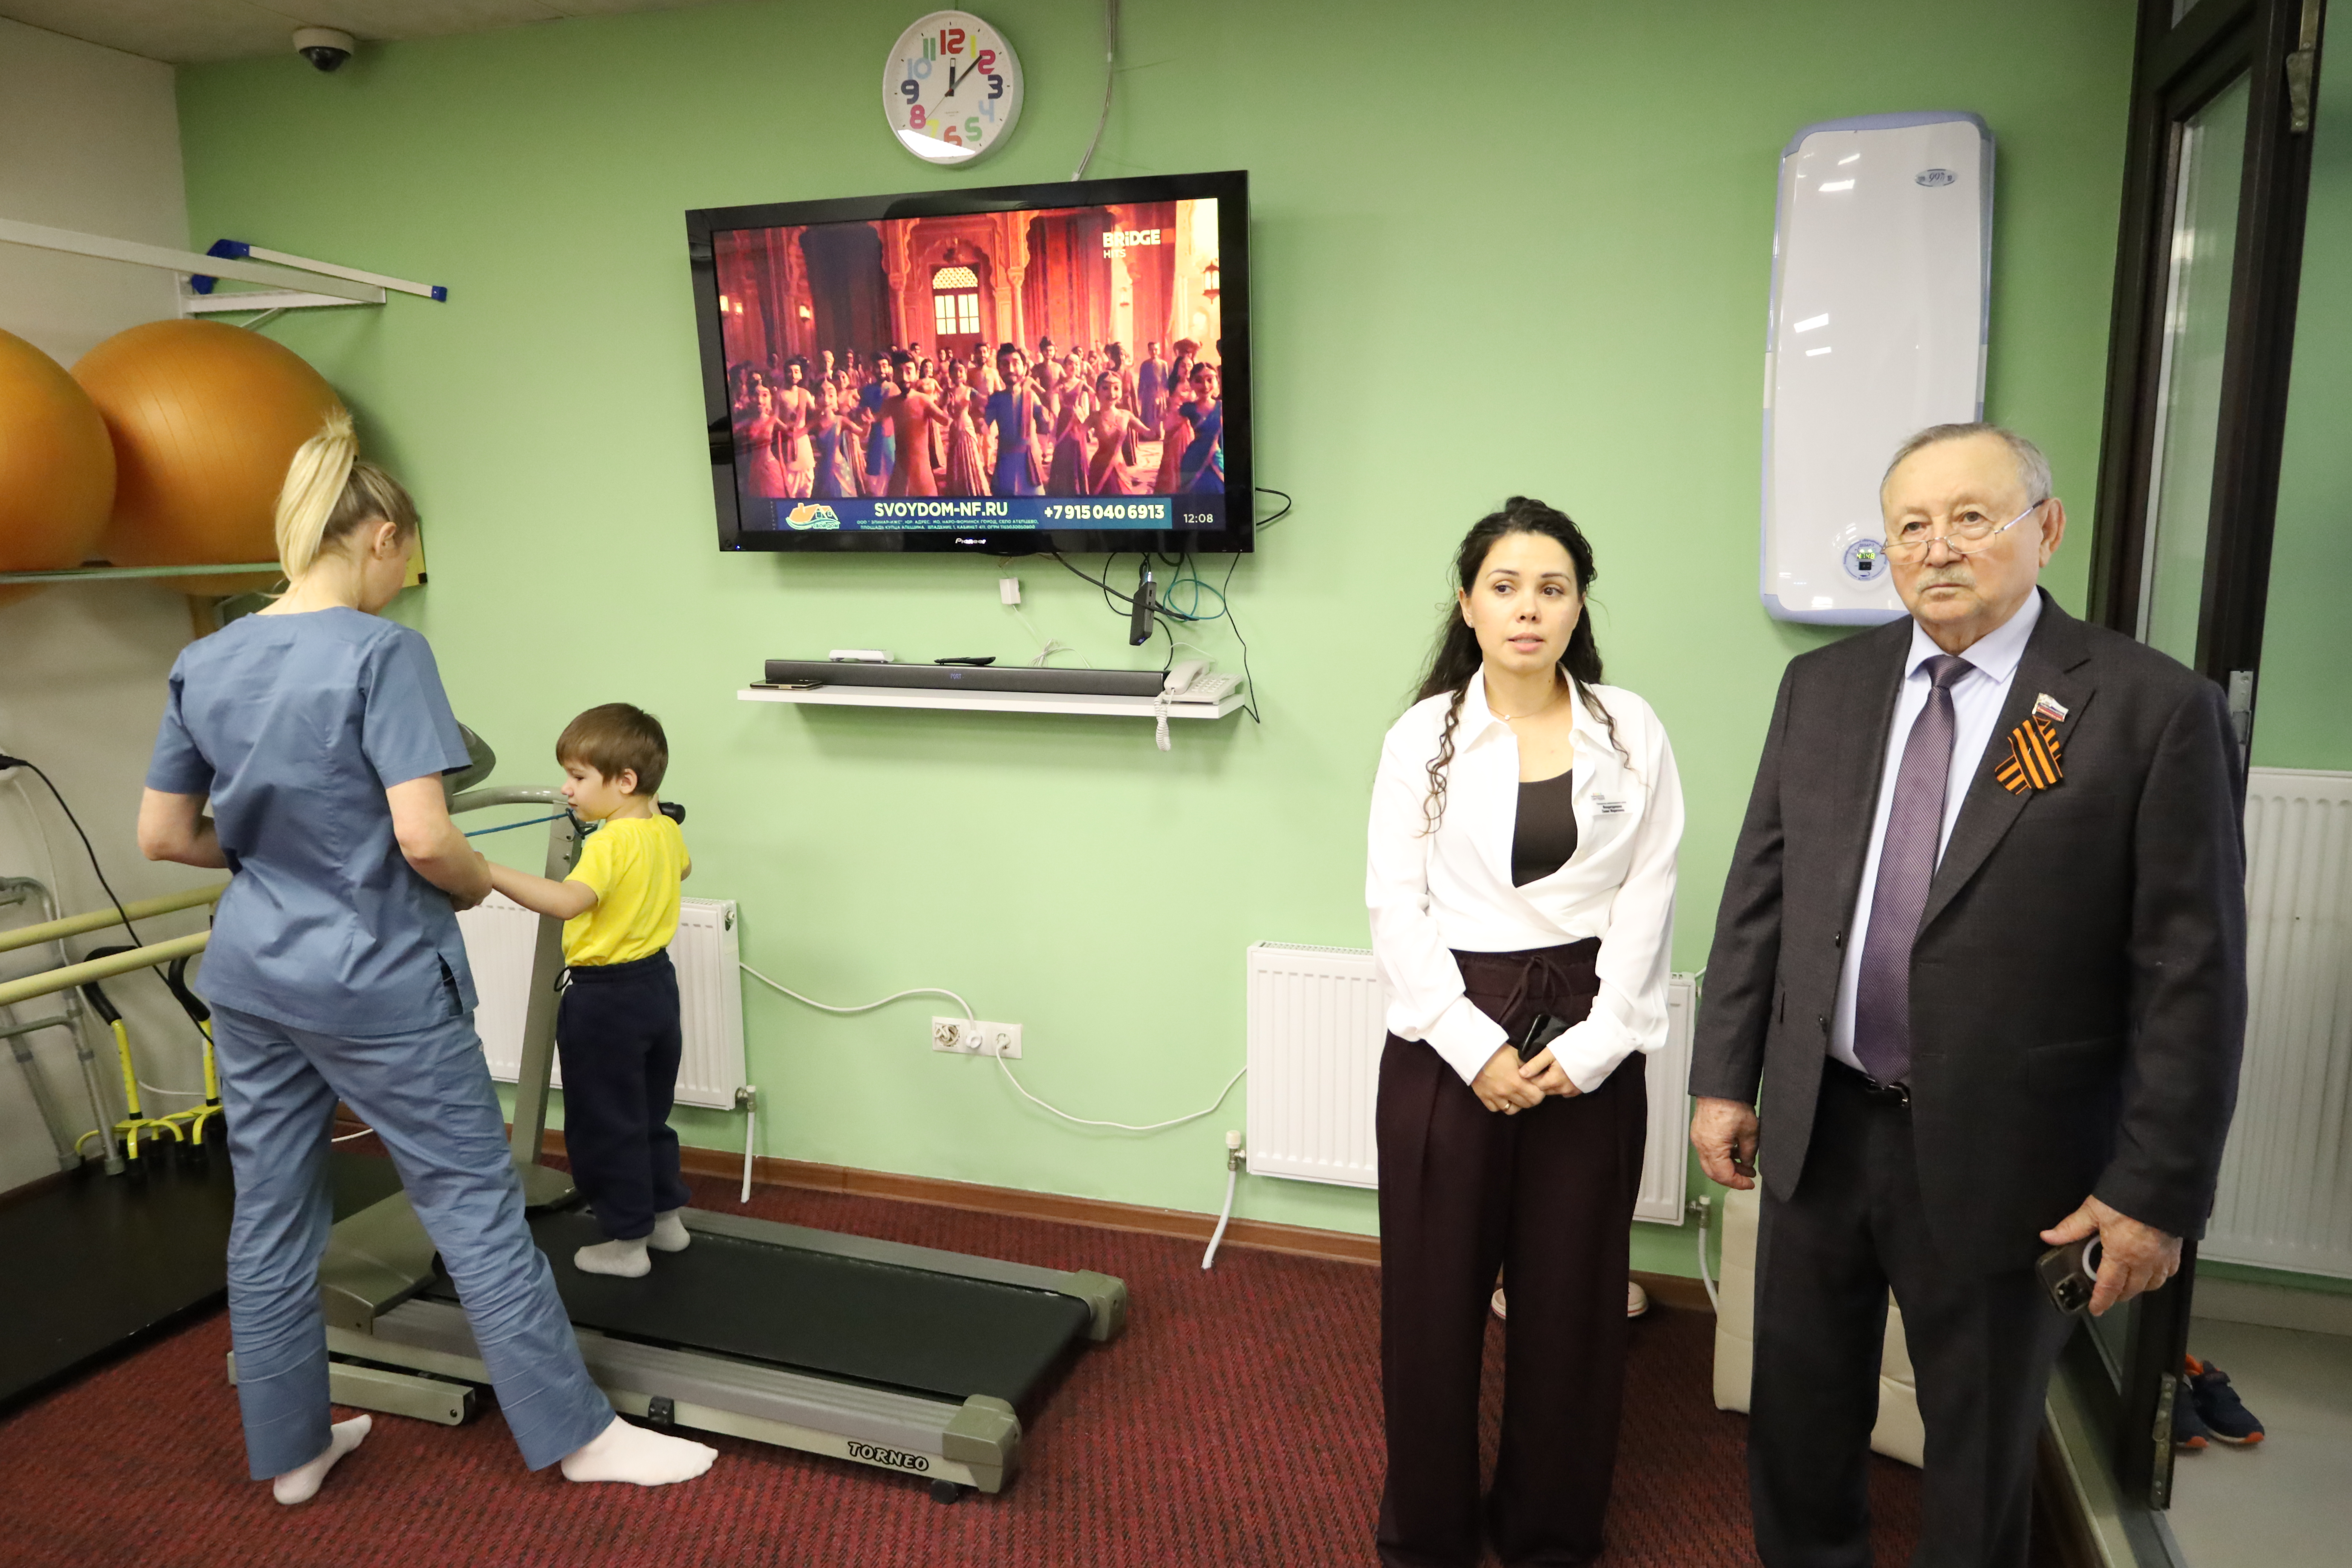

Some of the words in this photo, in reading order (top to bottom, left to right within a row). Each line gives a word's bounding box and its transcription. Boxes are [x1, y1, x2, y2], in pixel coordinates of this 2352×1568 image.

[923, 37, 936, 61] 11
[940, 28, 965, 55] 12
[970, 35, 977, 58] 1
[907, 57, 932, 80] 10
[978, 49, 996, 75] 2
[901, 79, 919, 105] 9
[988, 74, 1003, 99] 3
[910, 104, 926, 129] 8
[978, 100, 995, 123] 4
[926, 119, 940, 138] 7
[944, 126, 962, 147] 6
[965, 116, 982, 142] 5
[1103, 249, 1126, 259] HITS
[874, 502, 1008, 517] SVOYDOM-NF.RU
[1127, 504, 1165, 519] 6913
[1184, 513, 1213, 523] 12:08
[848, 1441, 929, 1471] TORNEO
